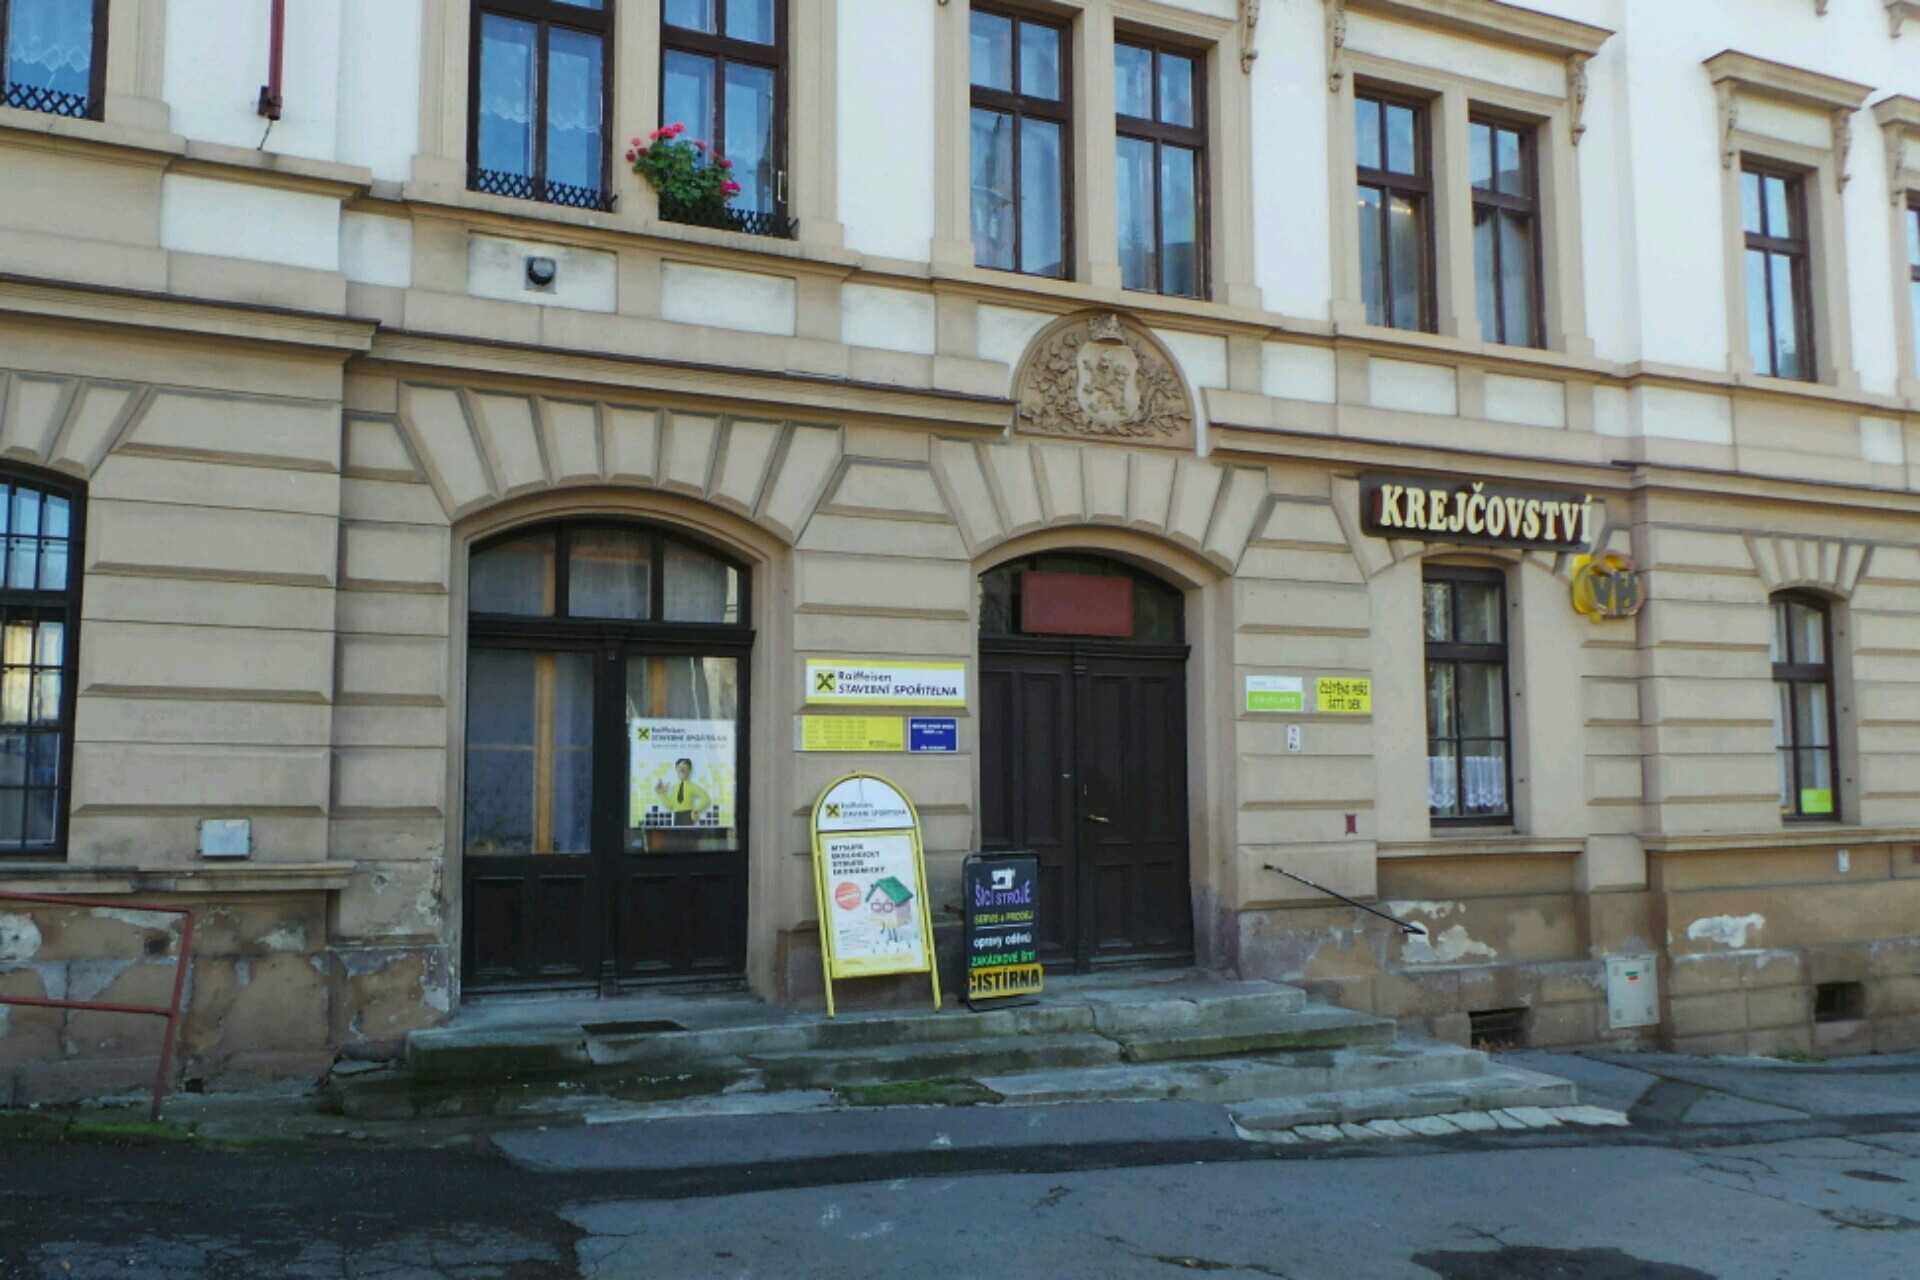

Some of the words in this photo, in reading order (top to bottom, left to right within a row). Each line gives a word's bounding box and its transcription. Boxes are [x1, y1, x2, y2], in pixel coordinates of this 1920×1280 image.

[1379, 481, 1593, 544] KREJČOVSTVÍ
[838, 671, 892, 682] Raiffeisen
[838, 683, 890, 695] STAVEBNÍ
[893, 684, 958, 696] SPOŘITELNA
[995, 880, 1032, 905] STROJE
[1006, 910, 1034, 922] PRODEJ
[973, 935, 1003, 950] opravy
[971, 951, 1019, 967] ZAKÁZKOVÉ
[969, 967, 1042, 993] ČISTÍRNA
